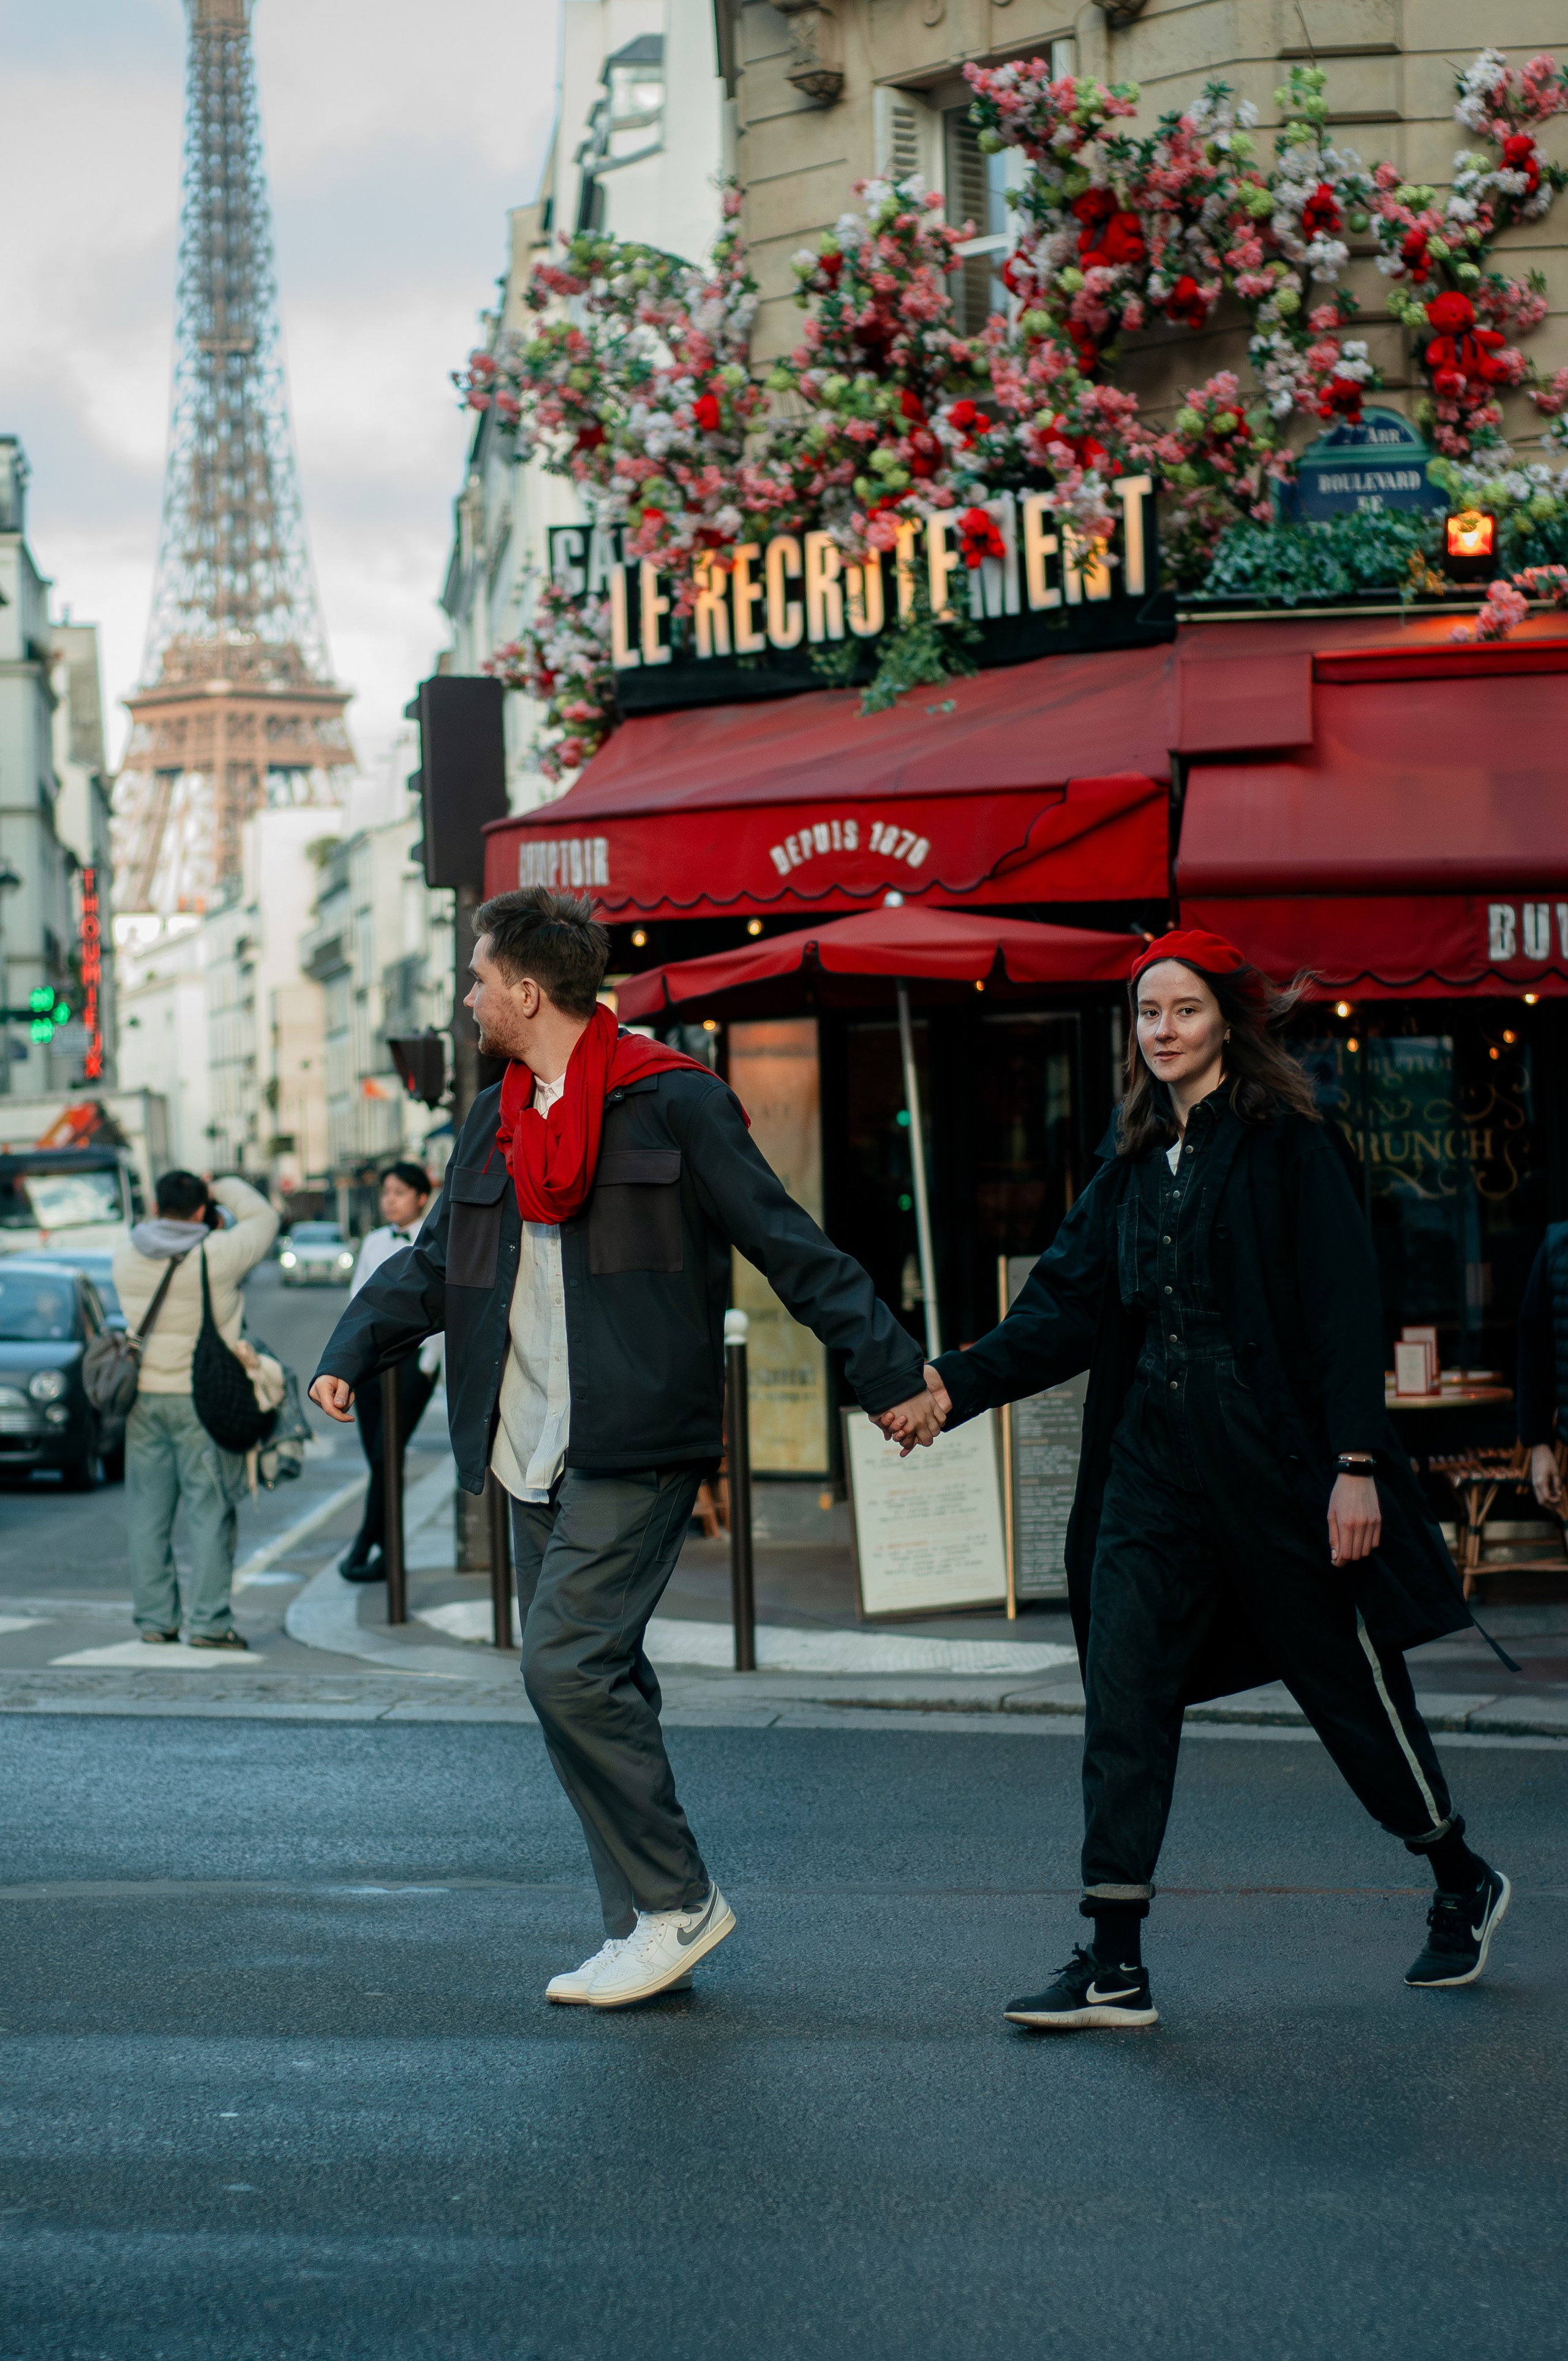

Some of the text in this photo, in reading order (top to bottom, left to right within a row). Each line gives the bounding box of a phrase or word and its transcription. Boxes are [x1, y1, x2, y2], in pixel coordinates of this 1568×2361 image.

[1318, 470, 1421, 494] BOULEVARD
[611, 560, 672, 670] LE
[769, 819, 930, 876] DEPUIS 1870
